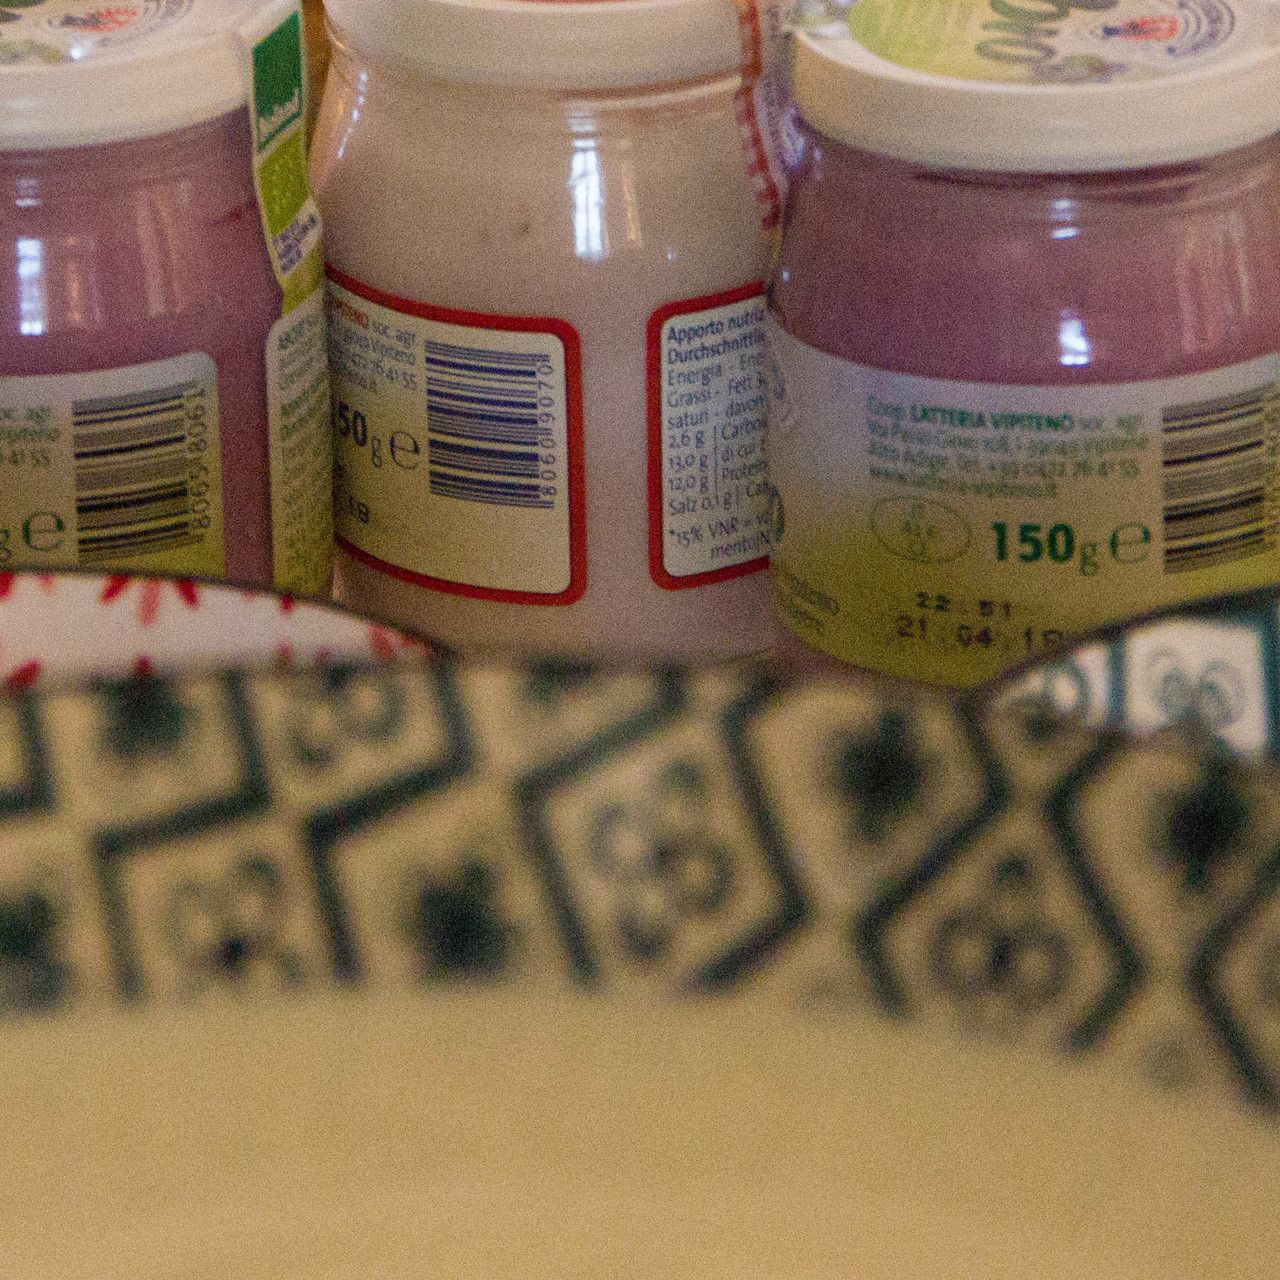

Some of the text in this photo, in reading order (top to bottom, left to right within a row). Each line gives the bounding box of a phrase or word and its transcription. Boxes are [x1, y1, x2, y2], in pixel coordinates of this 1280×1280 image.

[667, 319, 725, 348] Apporto
[667, 363, 723, 388] Energia
[667, 389, 712, 409] Grassi
[910, 403, 987, 429] LATTERIA
[332, 394, 383, 471] 50g
[668, 496, 698, 517] Salz
